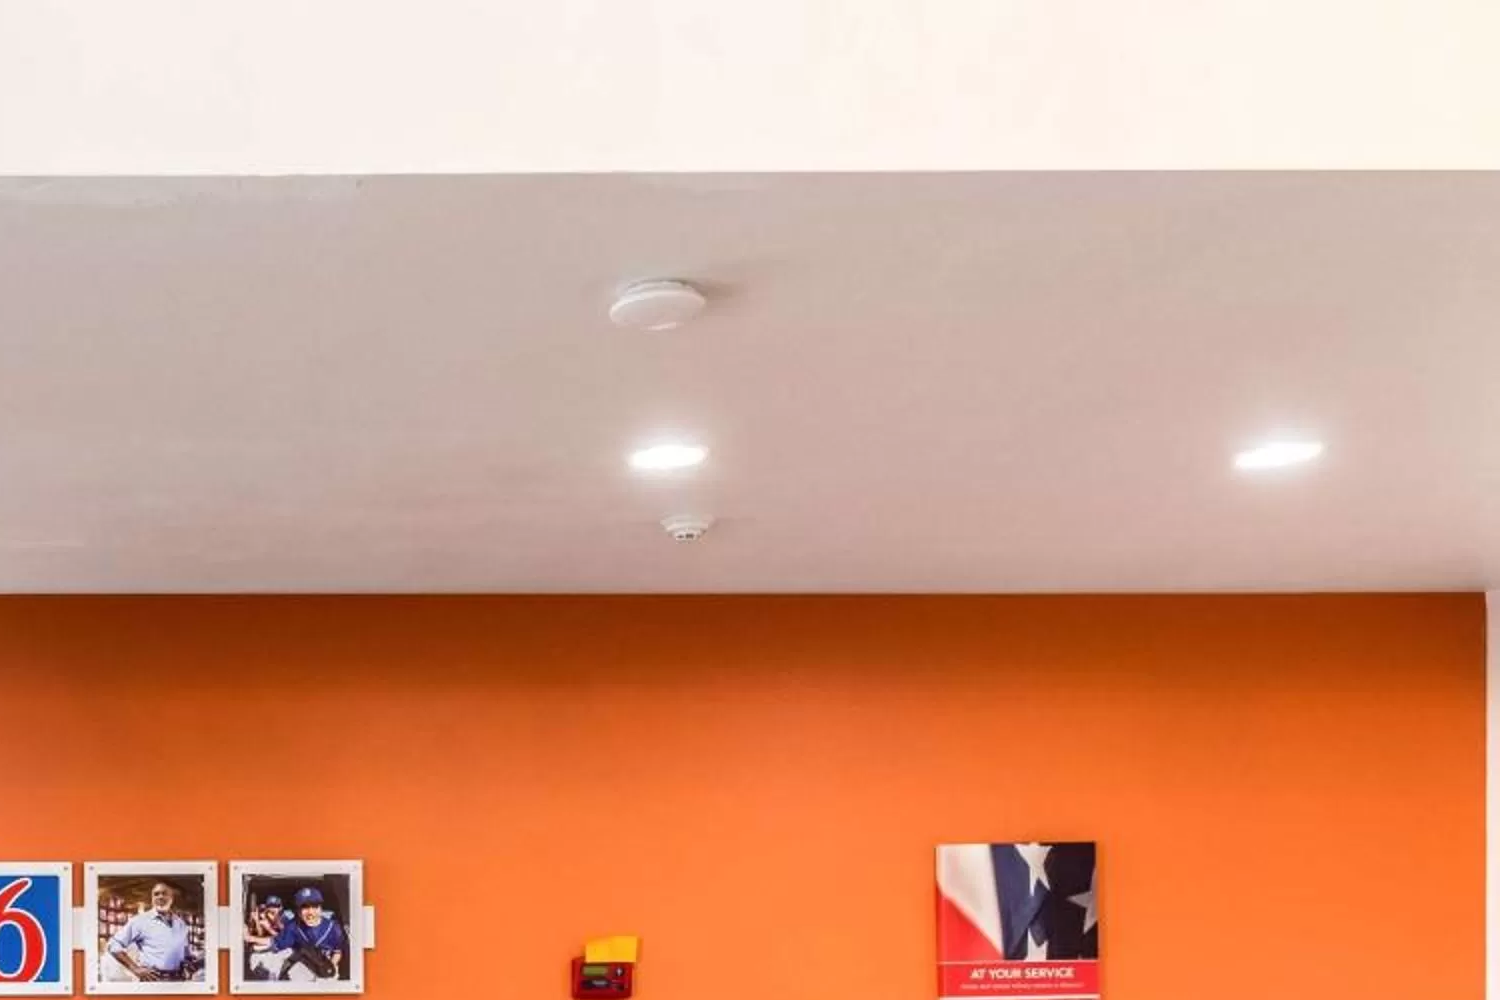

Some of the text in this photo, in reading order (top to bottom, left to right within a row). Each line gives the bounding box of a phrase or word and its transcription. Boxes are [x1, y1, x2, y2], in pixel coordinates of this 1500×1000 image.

[970, 967, 1075, 979] AT YOUR SERVICE
